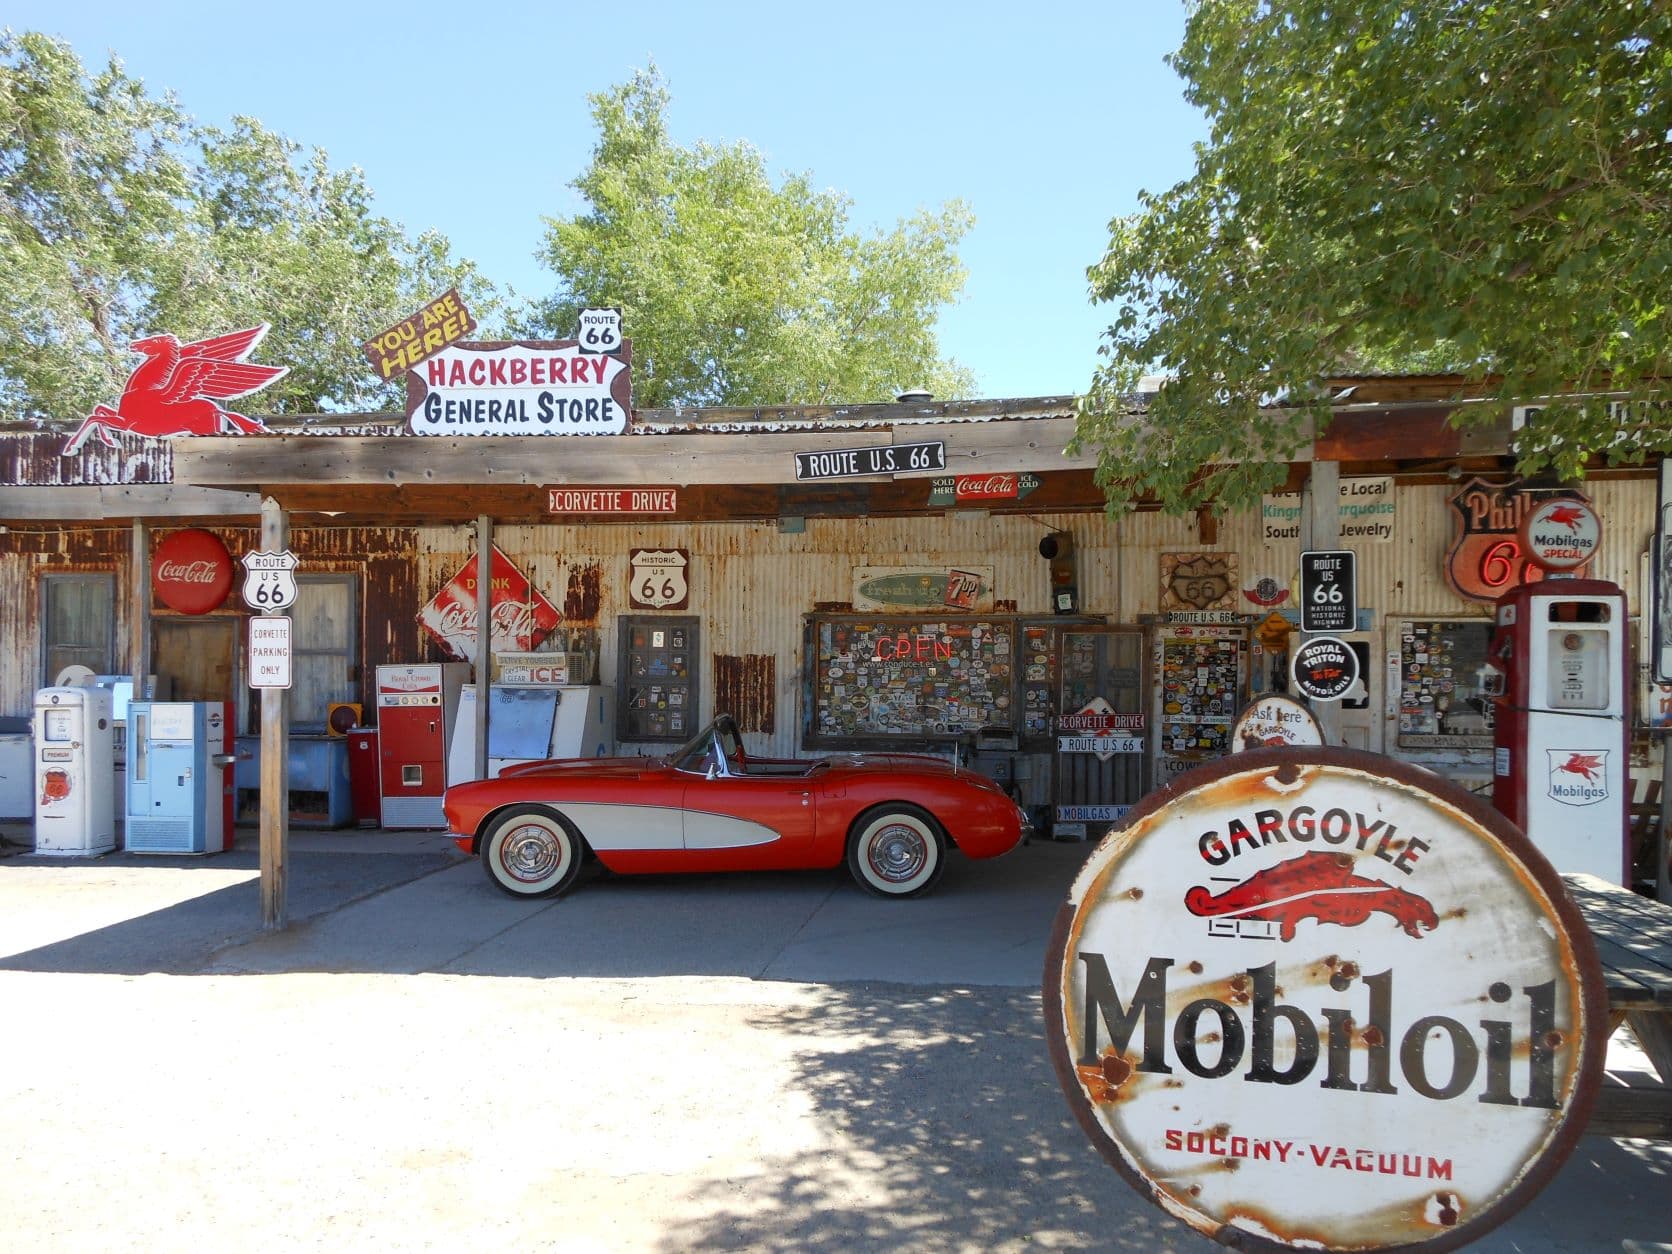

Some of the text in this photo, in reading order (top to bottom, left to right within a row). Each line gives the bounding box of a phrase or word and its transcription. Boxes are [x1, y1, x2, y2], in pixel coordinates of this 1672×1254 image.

[371, 294, 459, 357] YOU ARE
[583, 315, 616, 325] ROUTE
[585, 327, 615, 345] 66
[380, 310, 470, 379] HERE!
[427, 354, 609, 388] HACKBERRY
[424, 390, 614, 424] GENERAL STORE
[809, 446, 931, 477] ROUTE U.S. 66
[932, 478, 955, 487] SOLD
[956, 474, 1015, 496] Coca-Cola
[1017, 481, 1039, 489] COLD
[1020, 474, 1032, 482] ICE
[934, 486, 955, 495] HERE
[1350, 481, 1387, 496] Local
[554, 491, 671, 511] CORVETTE DRIVE
[1338, 522, 1393, 540] Jewelry
[1533, 534, 1594, 550] Mobilgas
[640, 556, 677, 565] HISTORIC
[1542, 548, 1584, 560] SPECIAL
[254, 558, 287, 568] ROUTE
[1312, 558, 1343, 571] ROUTE
[157, 559, 220, 584] Coca-Cola
[1321, 570, 1335, 583] US
[466, 577, 511, 590] DNK
[641, 577, 676, 600] 66
[1186, 581, 1215, 600] 66
[256, 583, 285, 605] 66
[1312, 583, 1344, 605] 66
[1172, 612, 1199, 621] ROUTE
[1219, 612, 1230, 621] 66
[253, 629, 288, 639] CORVETTE
[253, 647, 288, 657] PARKING
[1304, 644, 1342, 658] ROYAL
[1302, 653, 1347, 669] TRITON
[260, 665, 281, 675] ONLY
[529, 667, 565, 683] ICE
[1302, 680, 1335, 696] MOTOR
[1334, 675, 1351, 692] OILS
[1252, 706, 1273, 721] Ask
[1063, 715, 1141, 729] CORVETTE DRIVE
[1259, 726, 1297, 741] GARGOYLE
[1068, 739, 1097, 751] ROUTE
[1122, 739, 1134, 751] 66
[1552, 784, 1606, 800] Mobilgas
[1064, 807, 1112, 820] MOBILGAS
[1198, 805, 1431, 876] GARGOYLE
[1075, 951, 1563, 1111] Mobiloil
[1165, 1128, 1454, 1182] SOCONY-VACUUM
